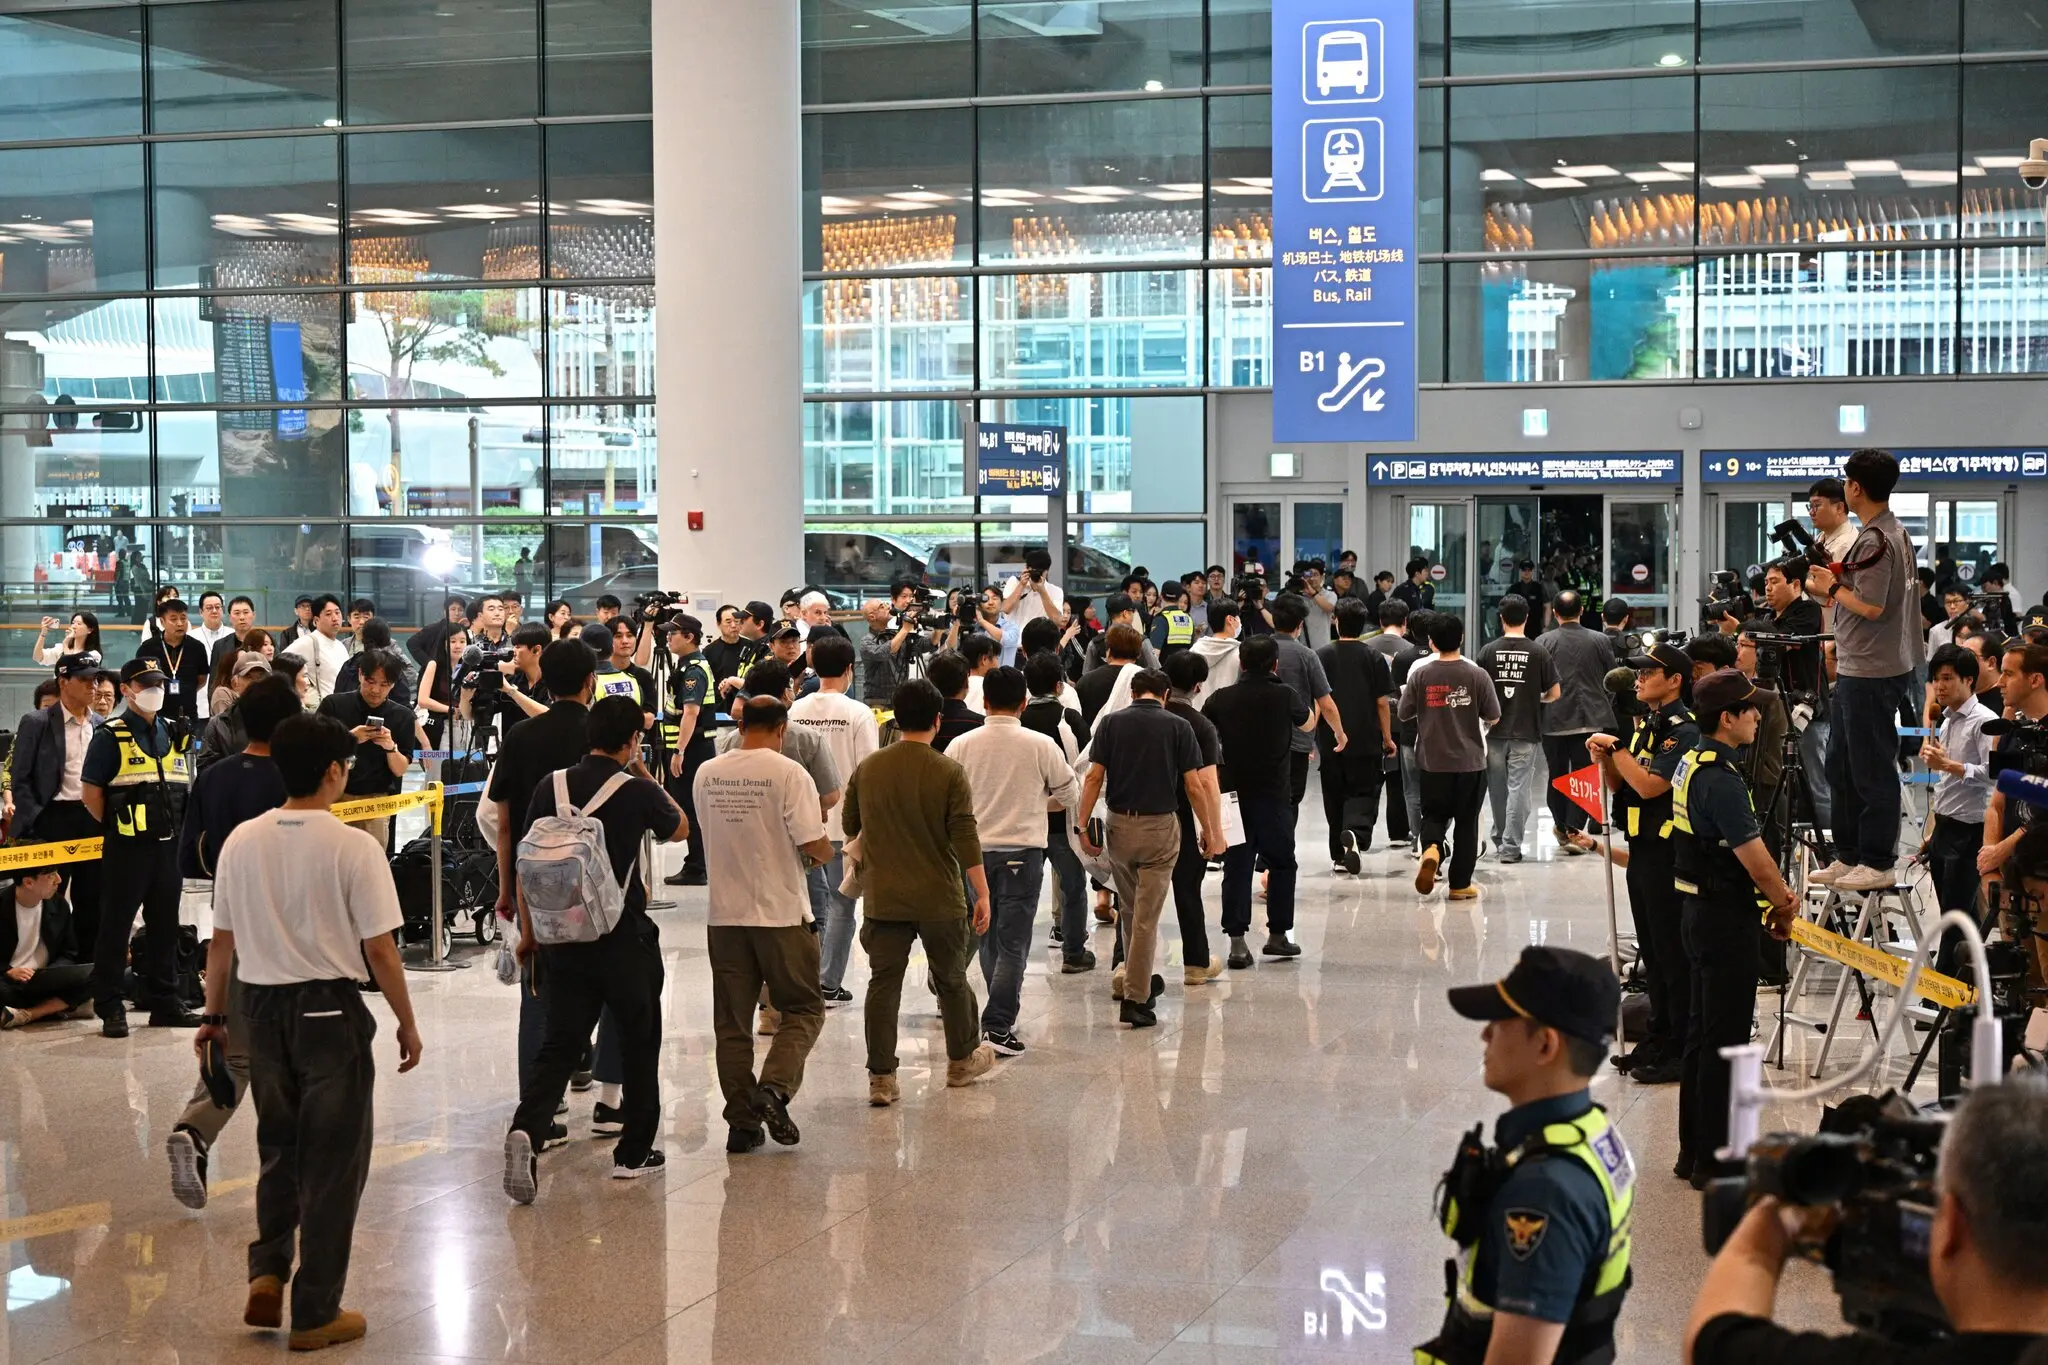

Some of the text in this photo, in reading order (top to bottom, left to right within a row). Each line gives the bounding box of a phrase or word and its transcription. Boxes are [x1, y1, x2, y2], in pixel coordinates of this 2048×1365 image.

[1309, 226, 1377, 246] 버스, 철도
[1314, 268, 1372, 283] バス, 鉄道
[1313, 288, 1372, 304] Bus, Rail
[1300, 351, 1325, 372] B1
[1726, 458, 1740, 477] 9
[1744, 462, 1757, 472] 10
[1496, 654, 1529, 663] THE FUTURE
[1504, 662, 1518, 670] IS IN
[1498, 670, 1523, 679] THE PAST
[419, 751, 450, 759] SECURITY
[712, 777, 772, 788] Mount Denali
[343, 806, 364, 816] SECURITY
[364, 804, 375, 814] LINE
